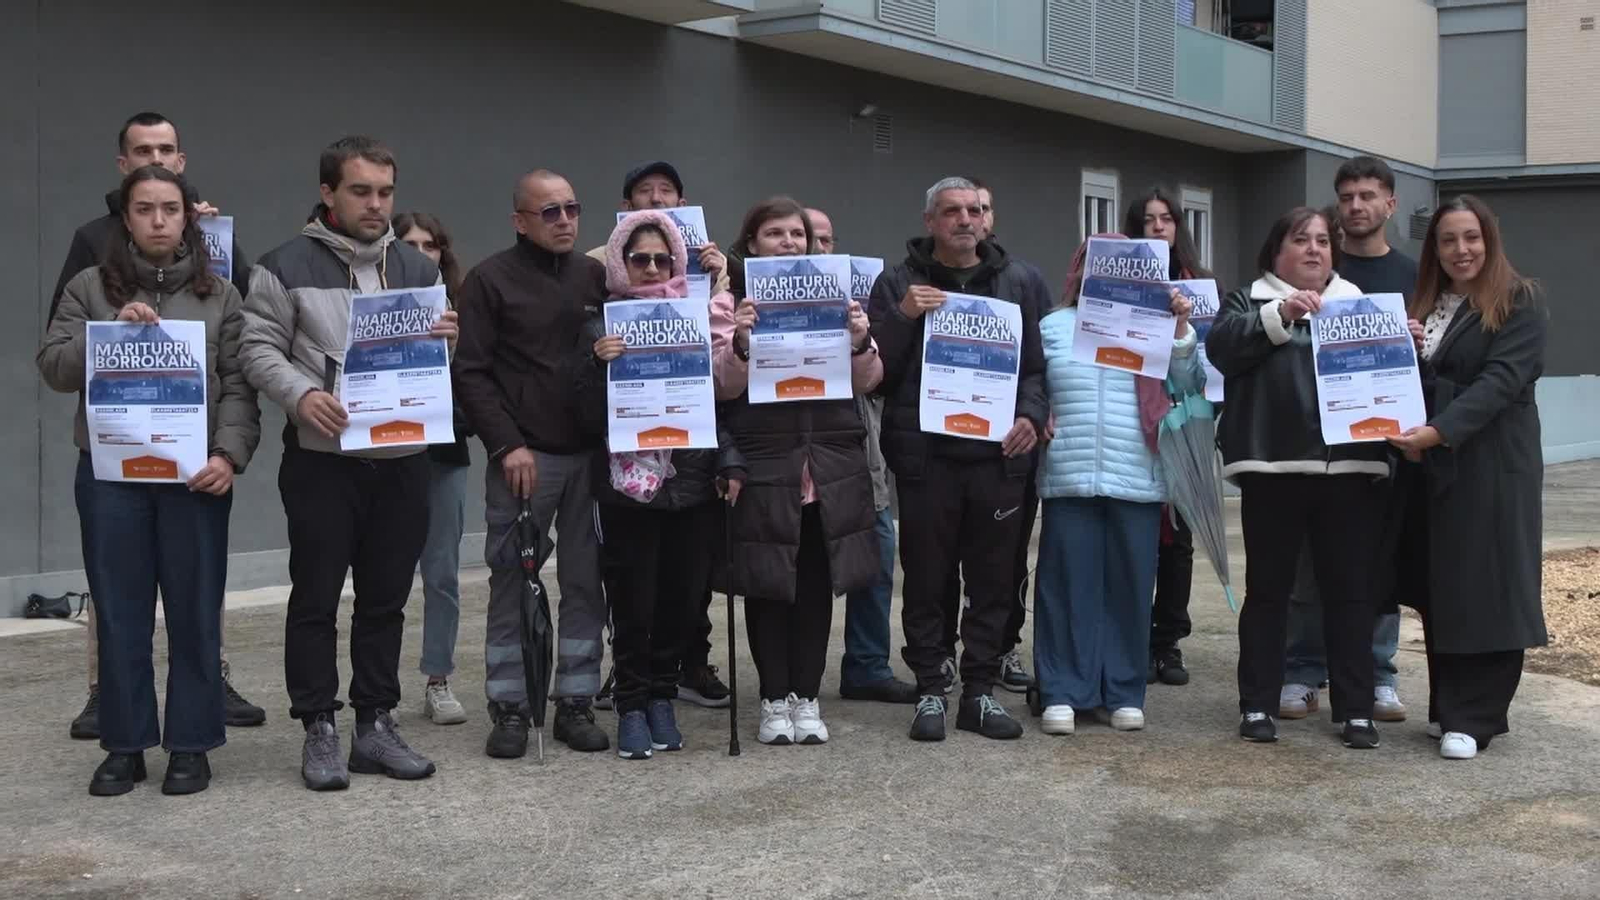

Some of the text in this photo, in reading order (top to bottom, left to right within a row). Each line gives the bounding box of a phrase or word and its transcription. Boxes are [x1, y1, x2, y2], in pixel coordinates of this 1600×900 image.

[1093, 256, 1164, 270] MARITUR
[753, 274, 836, 289] MARITURRI
[754, 286, 844, 300] BORROKAN.
[356, 308, 433, 328] MARITURRI
[933, 310, 1009, 330] MARITURRI
[1318, 312, 1397, 331] MARITURRI
[613, 319, 697, 334] MARITURRI
[932, 320, 1015, 341] BORROKAN.
[1319, 323, 1406, 341] BORROKAN.
[620, 330, 704, 346] ORROKAN.
[95, 342, 190, 356] MARITURRI
[95, 354, 198, 369] BORROKAN.
